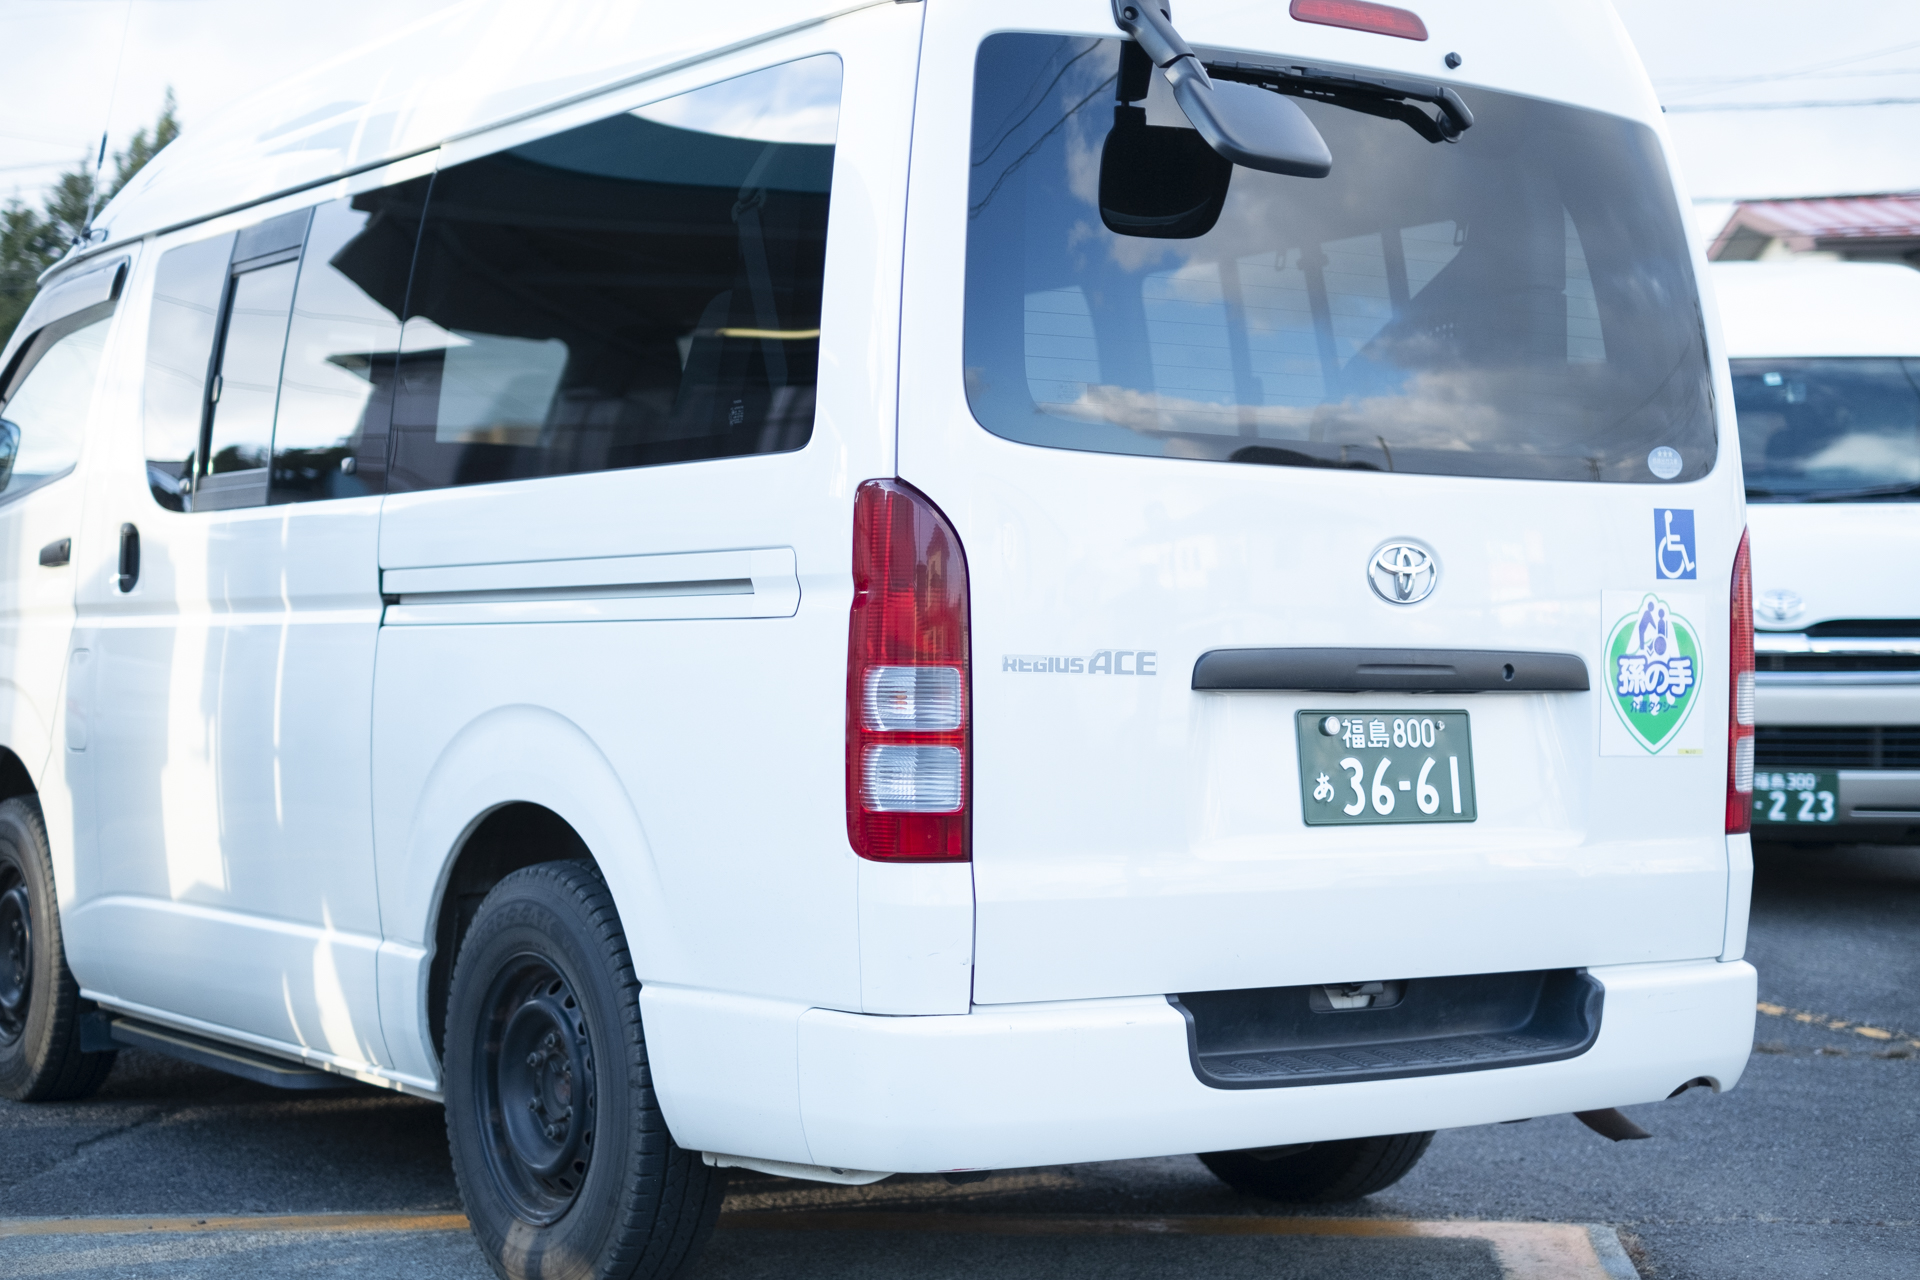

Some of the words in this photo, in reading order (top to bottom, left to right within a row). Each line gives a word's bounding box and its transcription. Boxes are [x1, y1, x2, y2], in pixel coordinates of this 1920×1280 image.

[1002, 655, 1084, 673] REGIUS
[1088, 650, 1157, 675] ACE
[1618, 656, 1693, 697] 孫の手
[1341, 718, 1389, 748] 福島
[1393, 718, 1436, 748] 800
[1313, 772, 1335, 802] あ
[1339, 756, 1462, 816] 36-61
